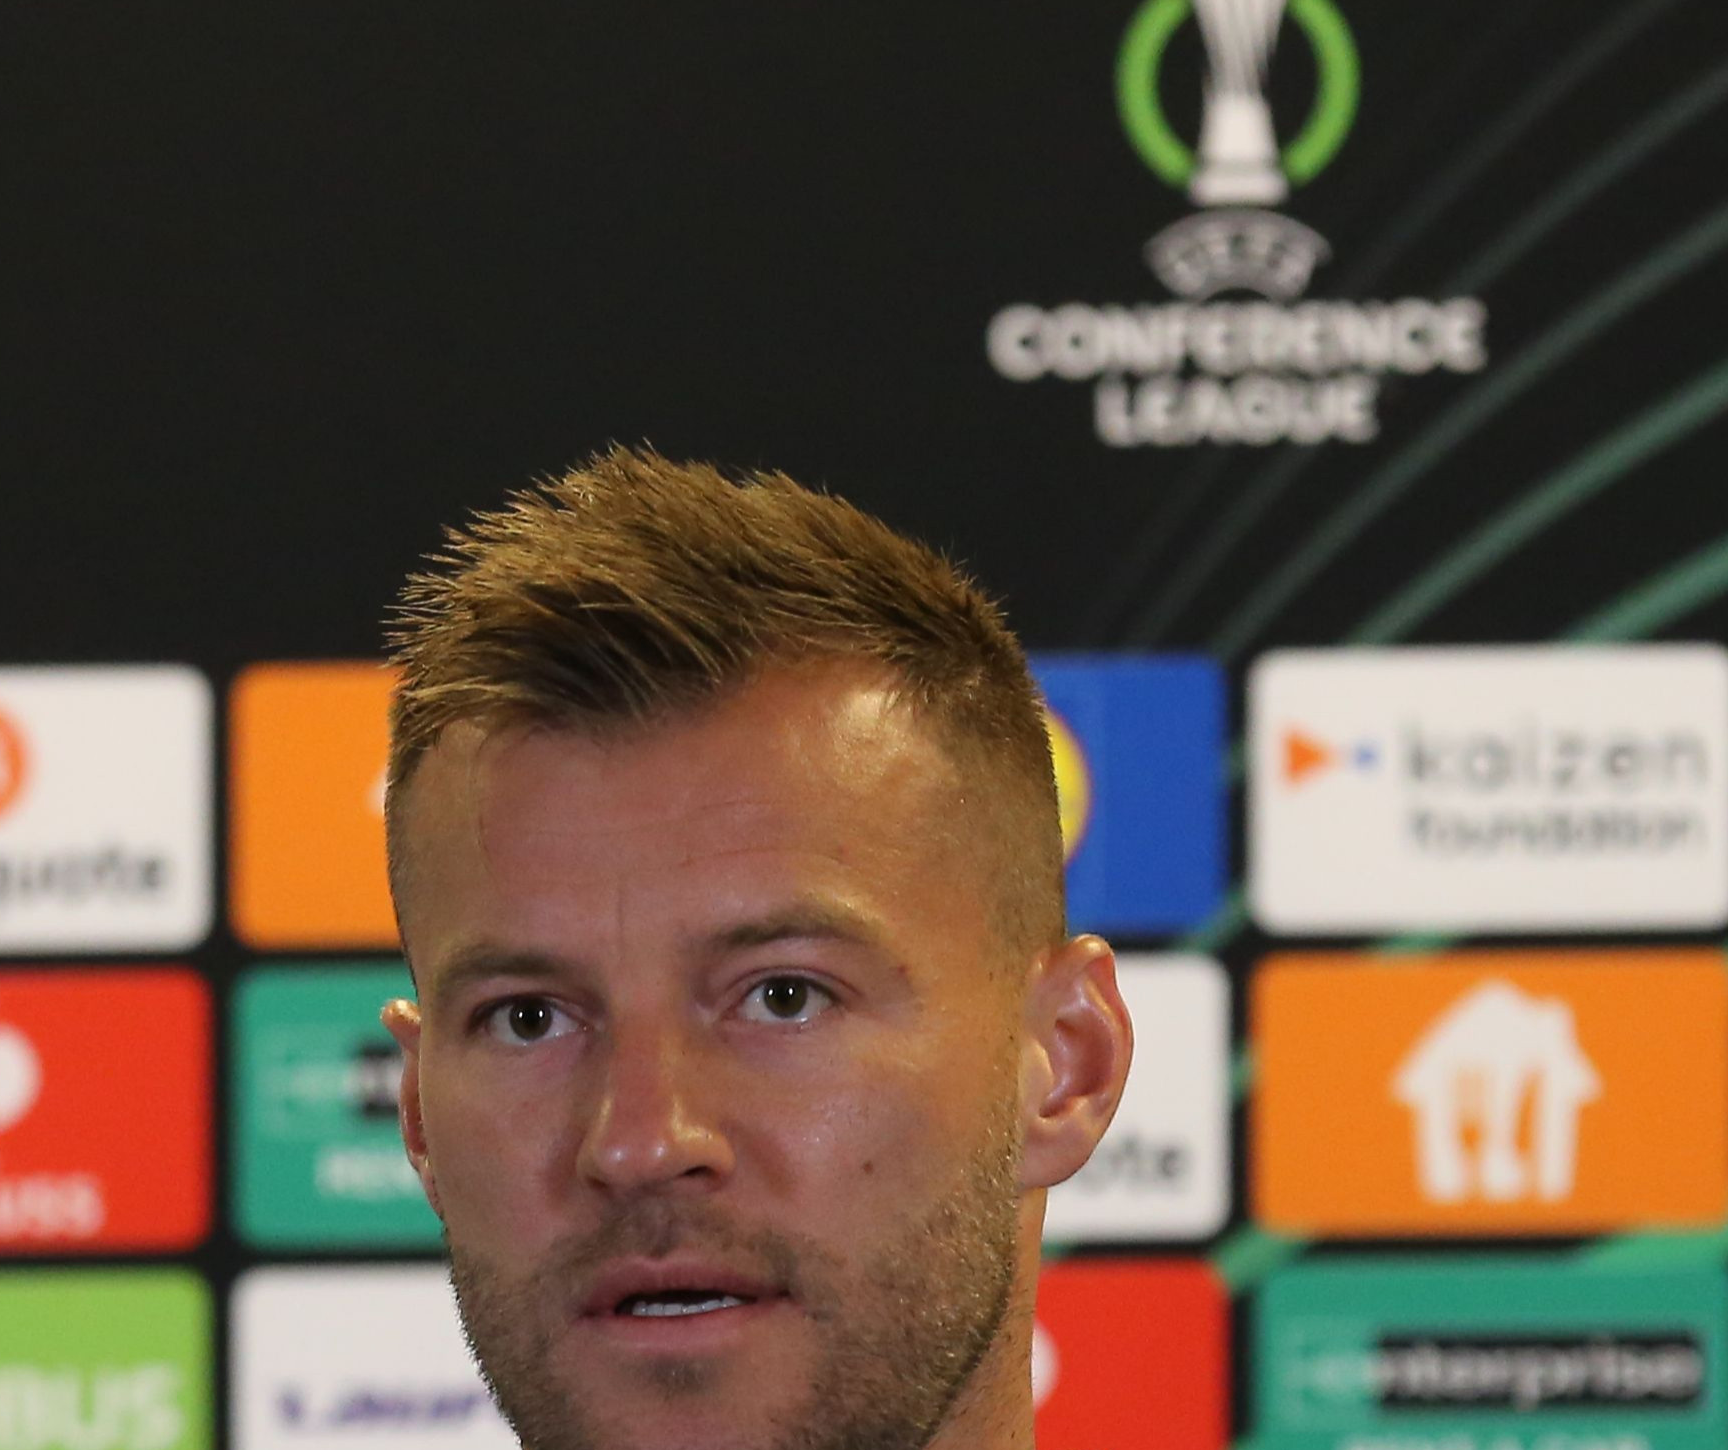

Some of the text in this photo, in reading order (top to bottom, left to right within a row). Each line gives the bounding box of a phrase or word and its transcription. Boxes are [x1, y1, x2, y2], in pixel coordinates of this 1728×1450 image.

[987, 298, 1487, 381] CONFERENCE
[1096, 376, 1379, 445] LEAGUE
[1402, 722, 1709, 782] kaizen
